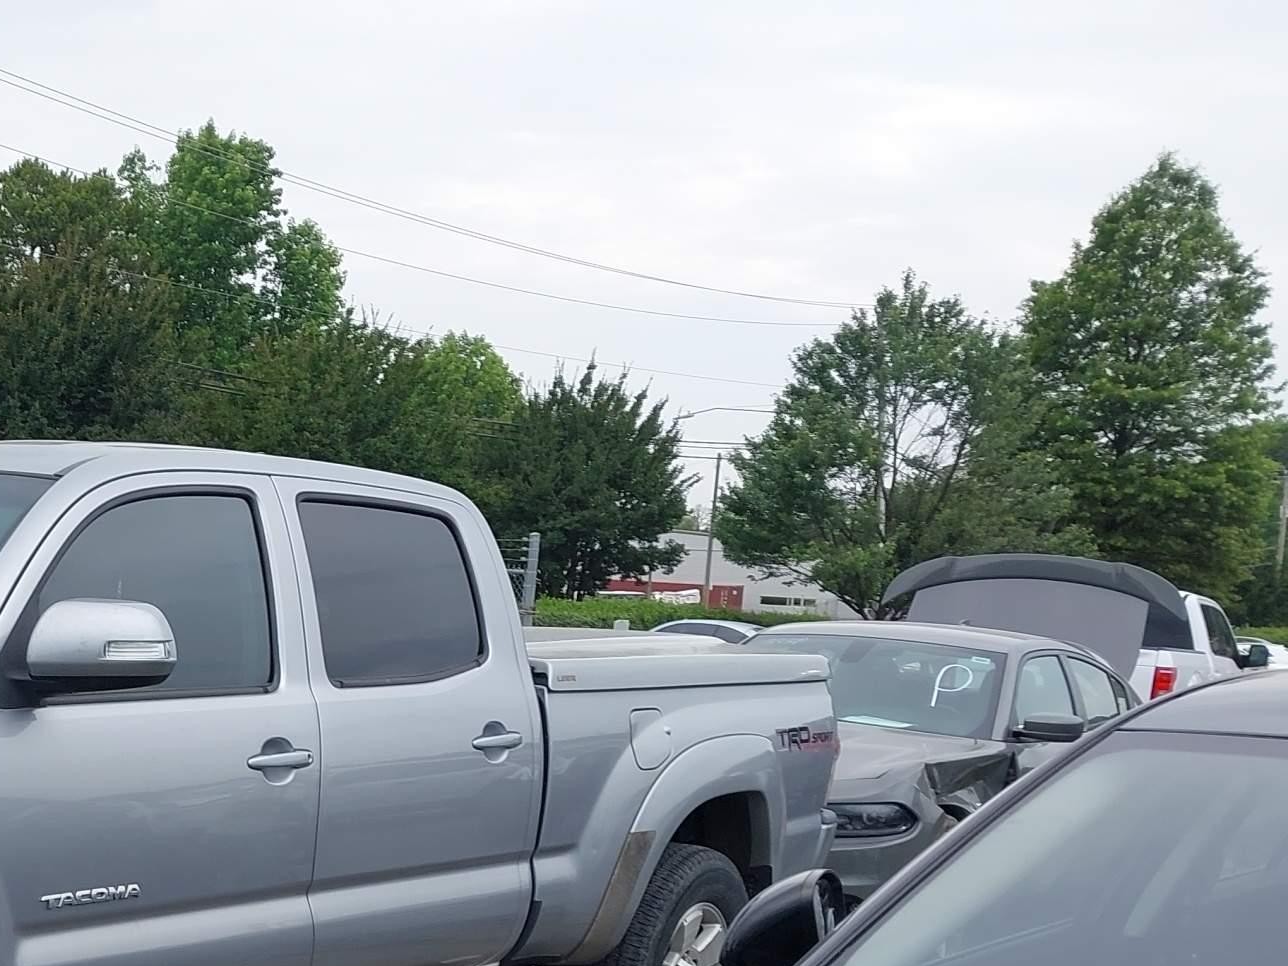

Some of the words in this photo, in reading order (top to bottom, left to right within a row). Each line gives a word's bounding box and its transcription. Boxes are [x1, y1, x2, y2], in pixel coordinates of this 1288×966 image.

[930, 663, 973, 708] P
[776, 726, 810, 751] TRD
[40, 883, 141, 909] TACOMA
